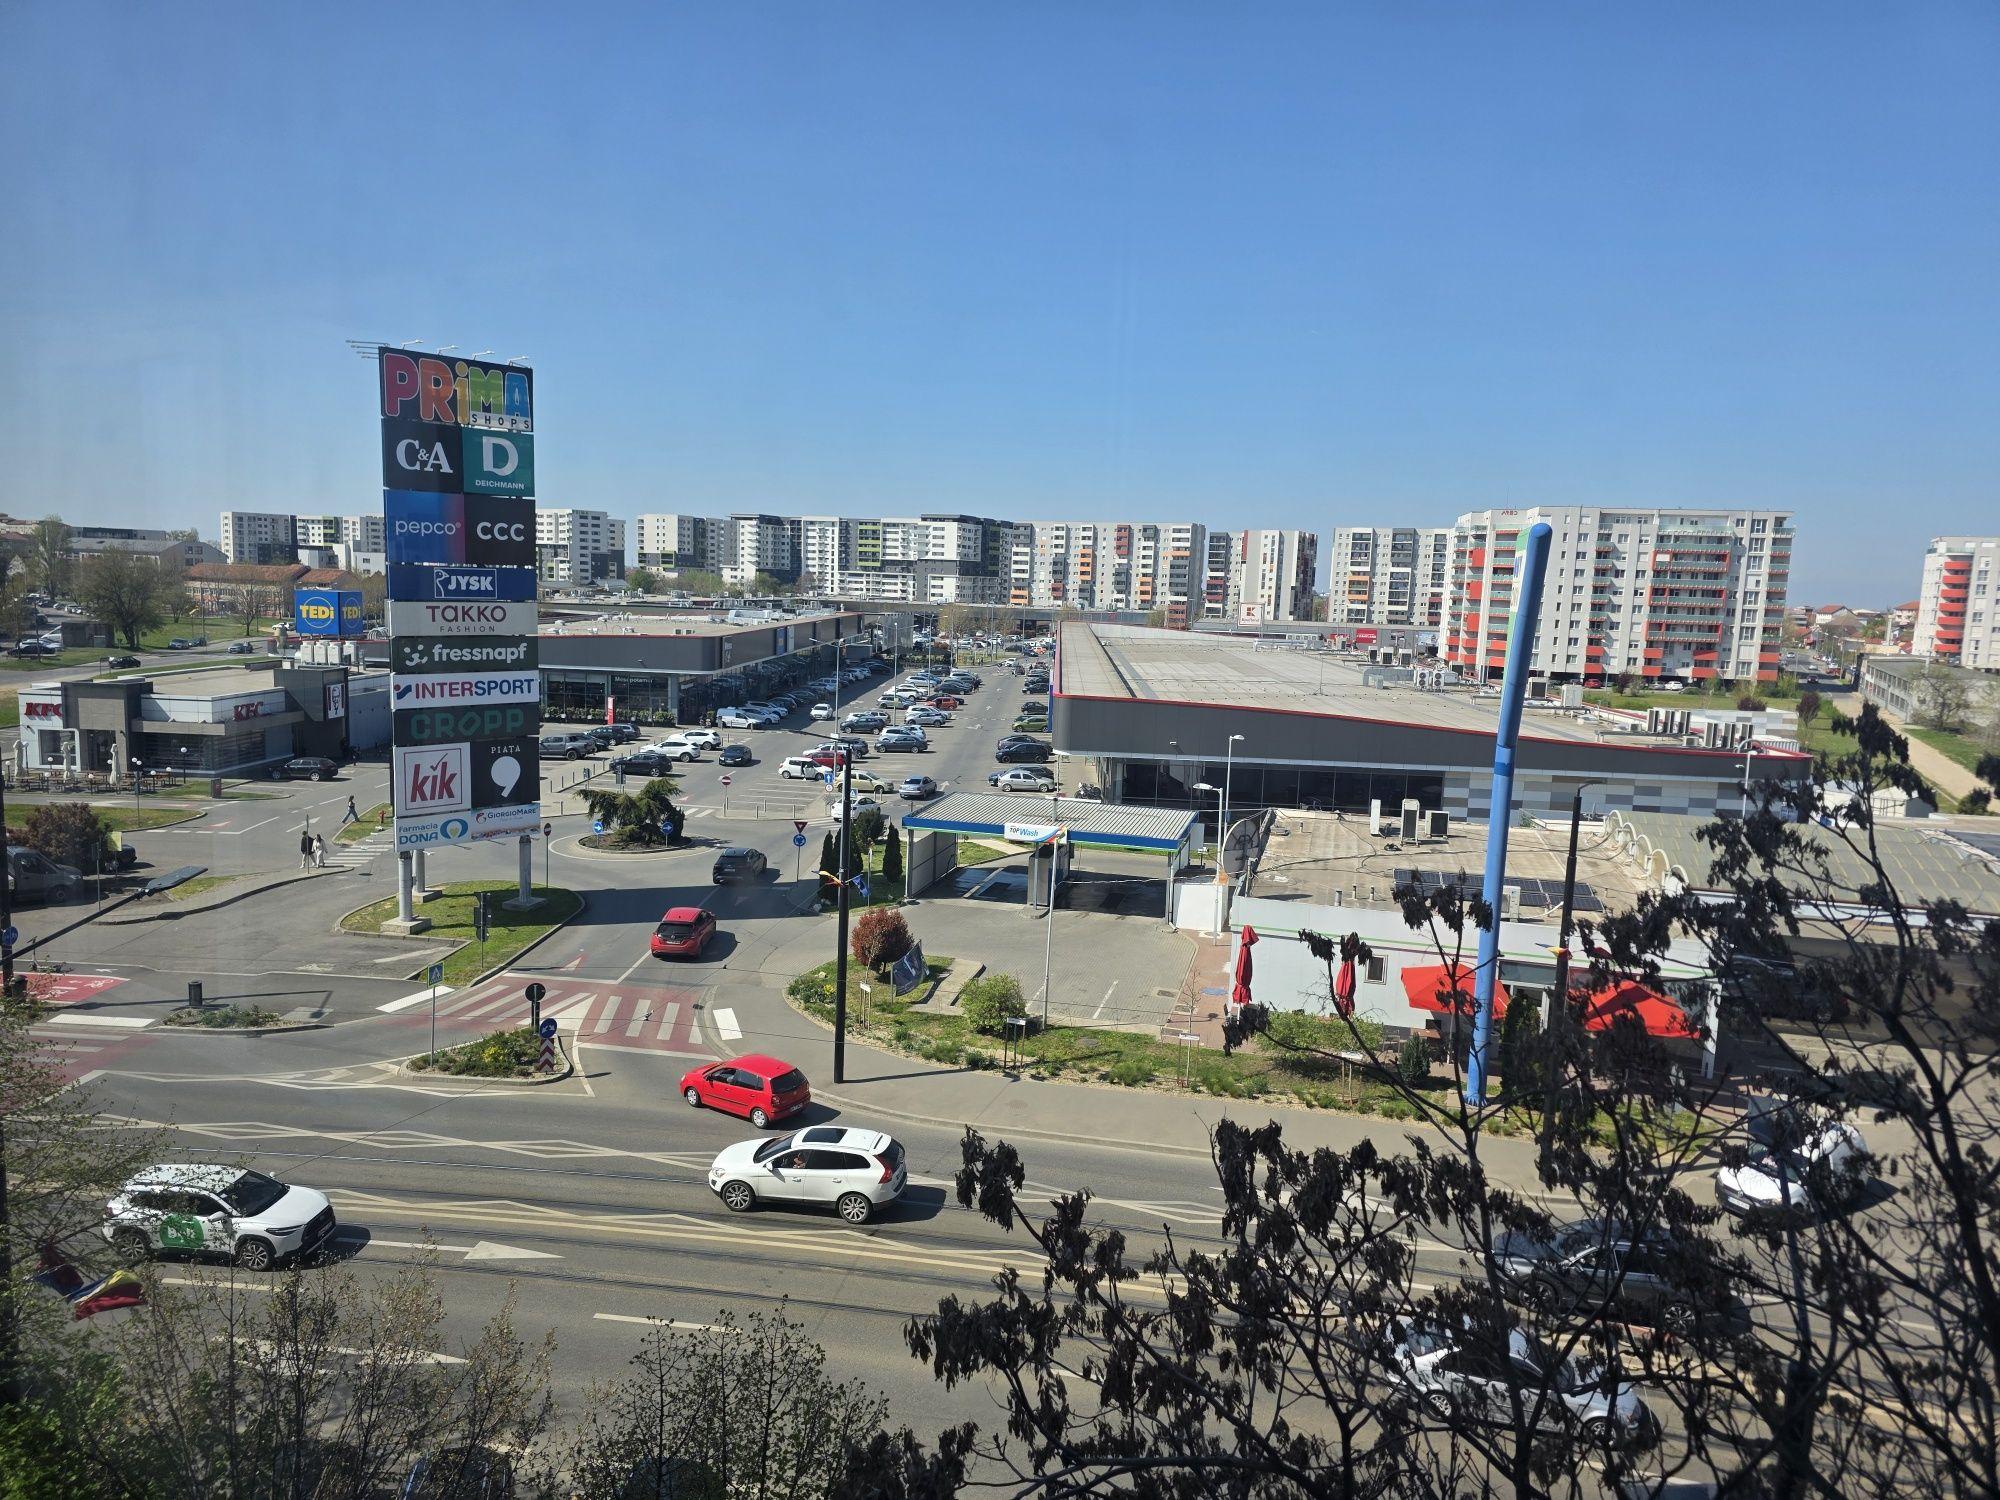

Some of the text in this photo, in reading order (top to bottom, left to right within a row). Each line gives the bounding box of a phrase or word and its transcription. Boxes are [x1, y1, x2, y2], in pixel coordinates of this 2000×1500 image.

[471, 414, 530, 429] SHOPS
[396, 438, 454, 474] C&A
[482, 436, 519, 477] D
[475, 479, 525, 490] DEICHMANN
[395, 520, 457, 537] pepco
[476, 521, 525, 542] CCC
[447, 575, 494, 591] JYSK
[300, 605, 335, 619] TEDi
[439, 625, 496, 633] FASHION
[432, 642, 528, 664] fressnapf
[415, 678, 535, 700] INTERSPORT
[410, 708, 525, 740] CROPP
[410, 754, 458, 803] kik
[399, 822, 438, 834] Farmacia
[1019, 828, 1039, 837] Wash
[399, 831, 439, 845] DONA
